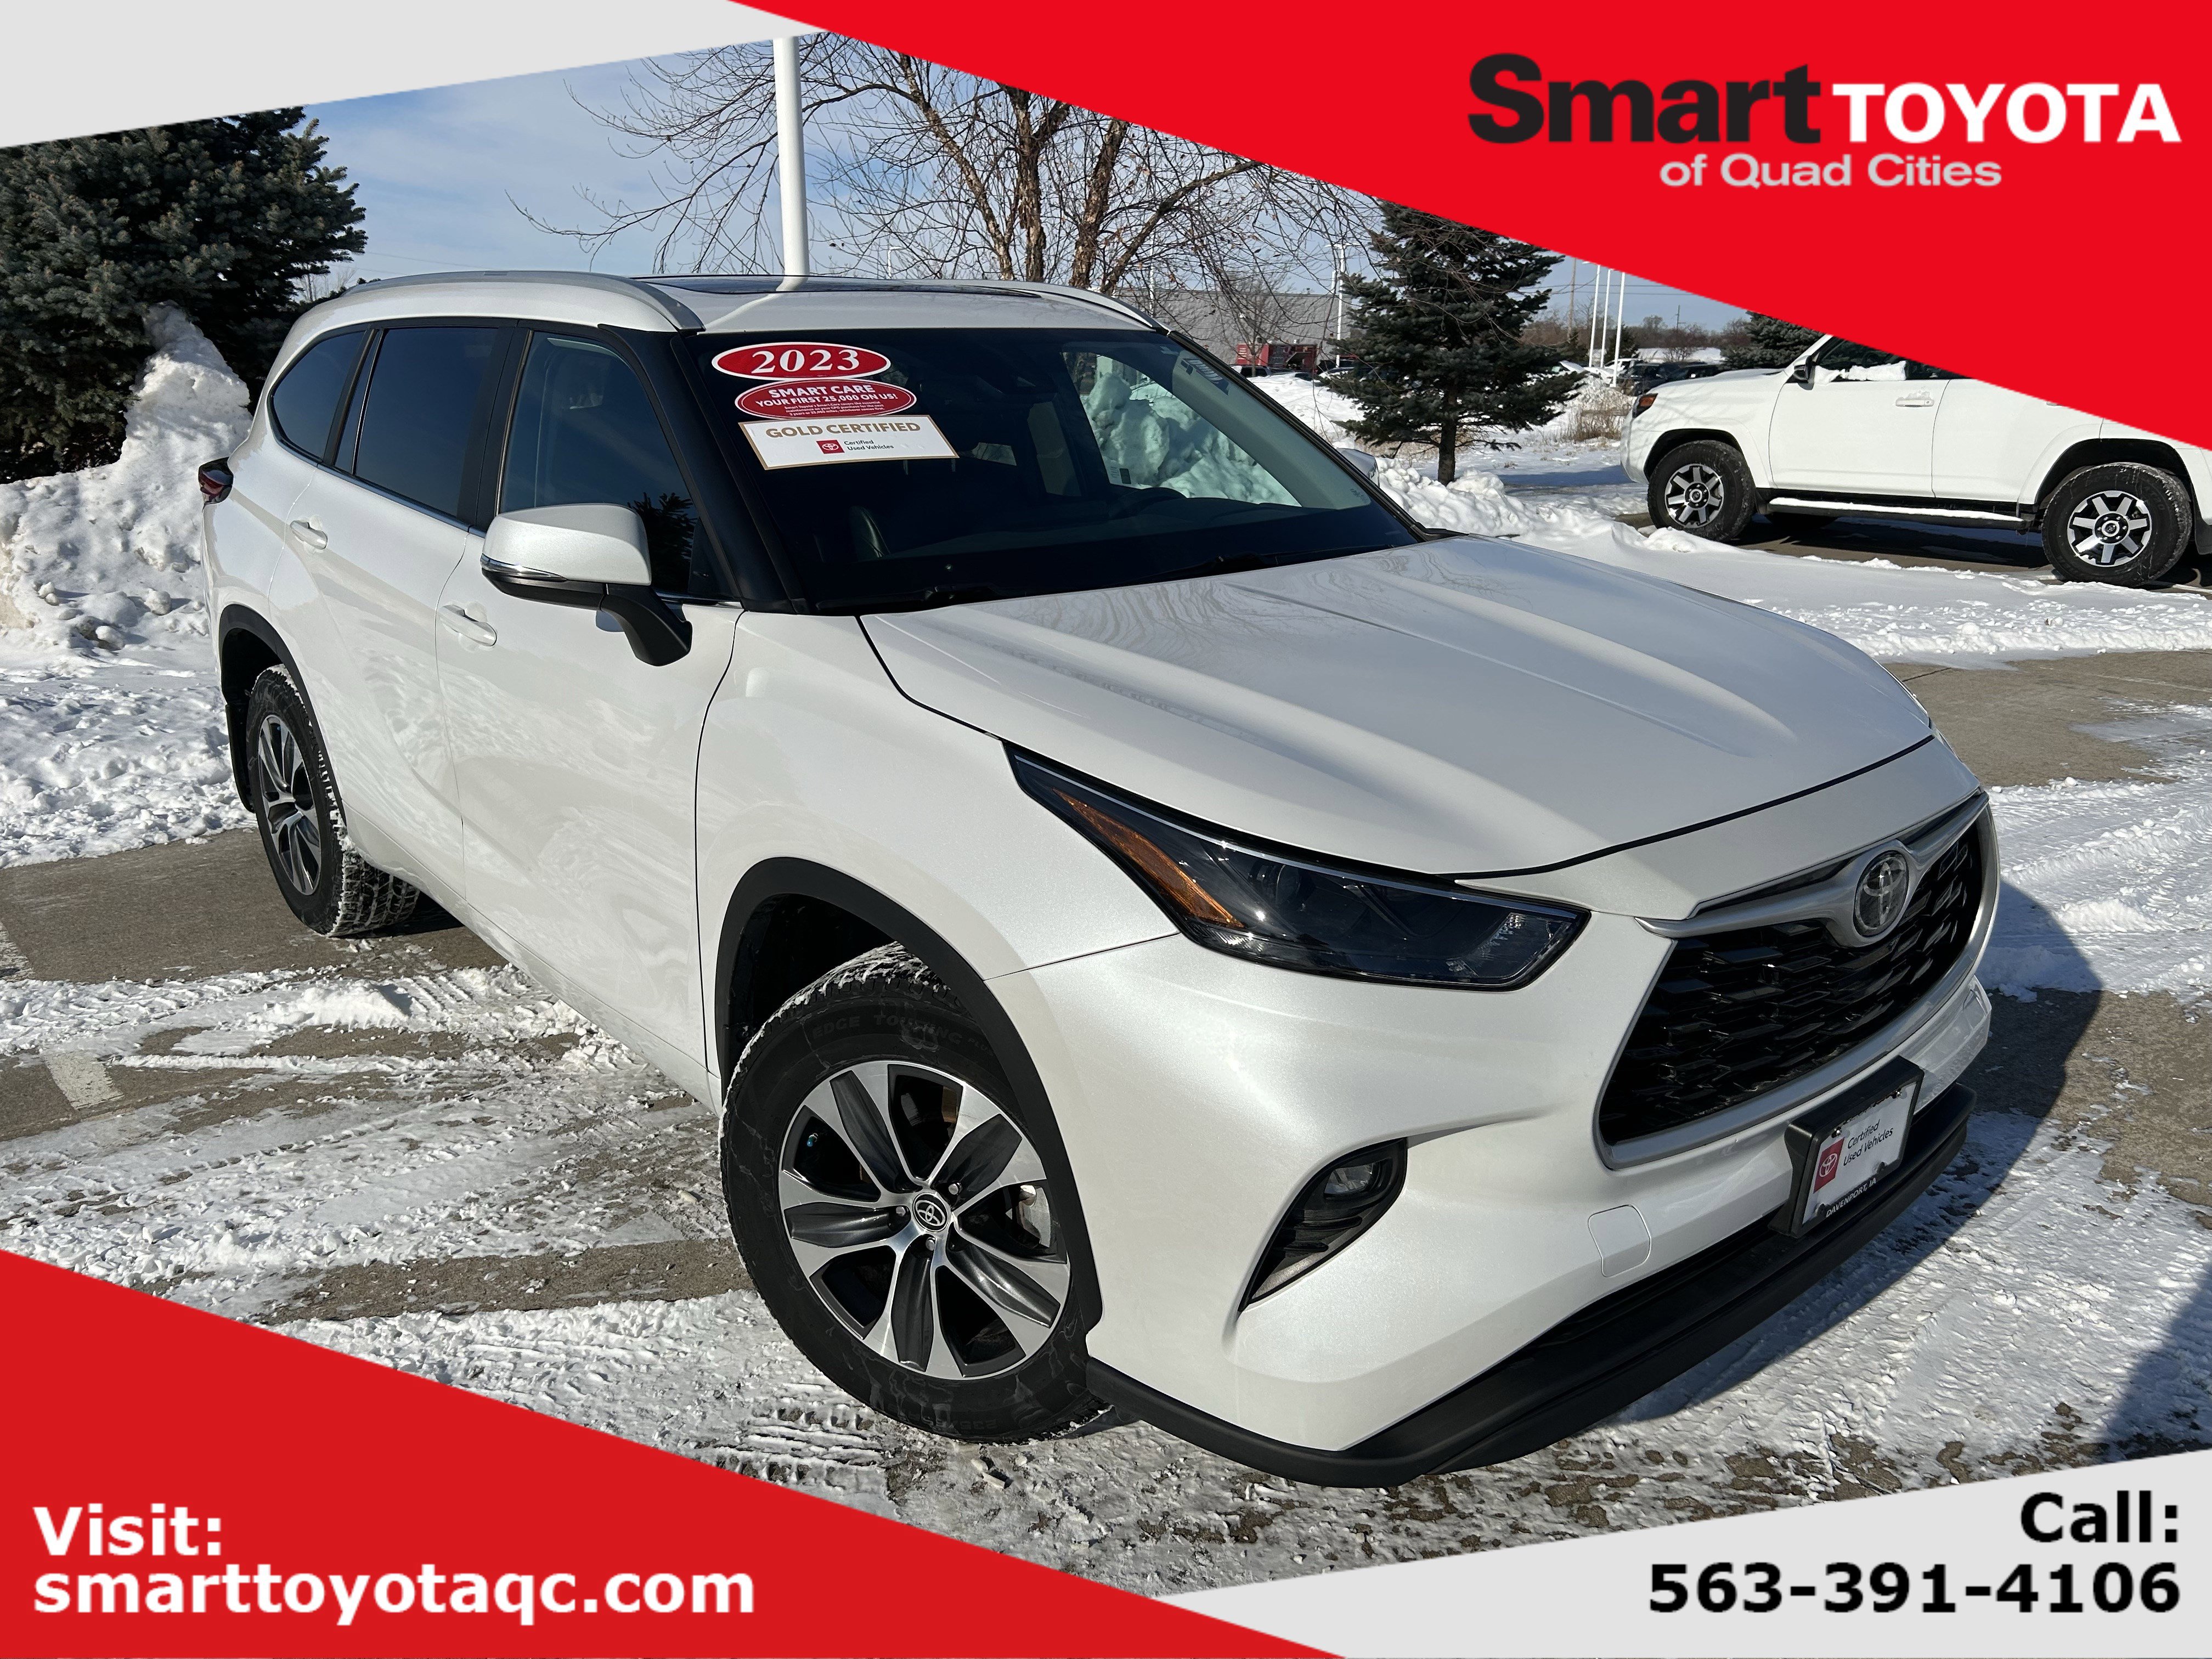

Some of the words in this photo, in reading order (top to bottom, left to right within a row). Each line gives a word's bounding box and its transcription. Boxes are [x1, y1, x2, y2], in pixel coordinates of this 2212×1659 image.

[751, 349, 860, 374] 2023
[768, 386, 828, 398] SMART
[831, 385, 876, 395] CARE
[755, 398, 791, 407] YOUR
[790, 396, 821, 405] FIRST
[765, 425, 823, 438] GOLD
[826, 422, 921, 434] CERTIFIED
[1848, 1119, 1880, 1149] Certified
[1843, 1144, 1864, 1166] Used
[1864, 1128, 1893, 1152] Vehicles
[1869, 1177, 1876, 1188] IA
